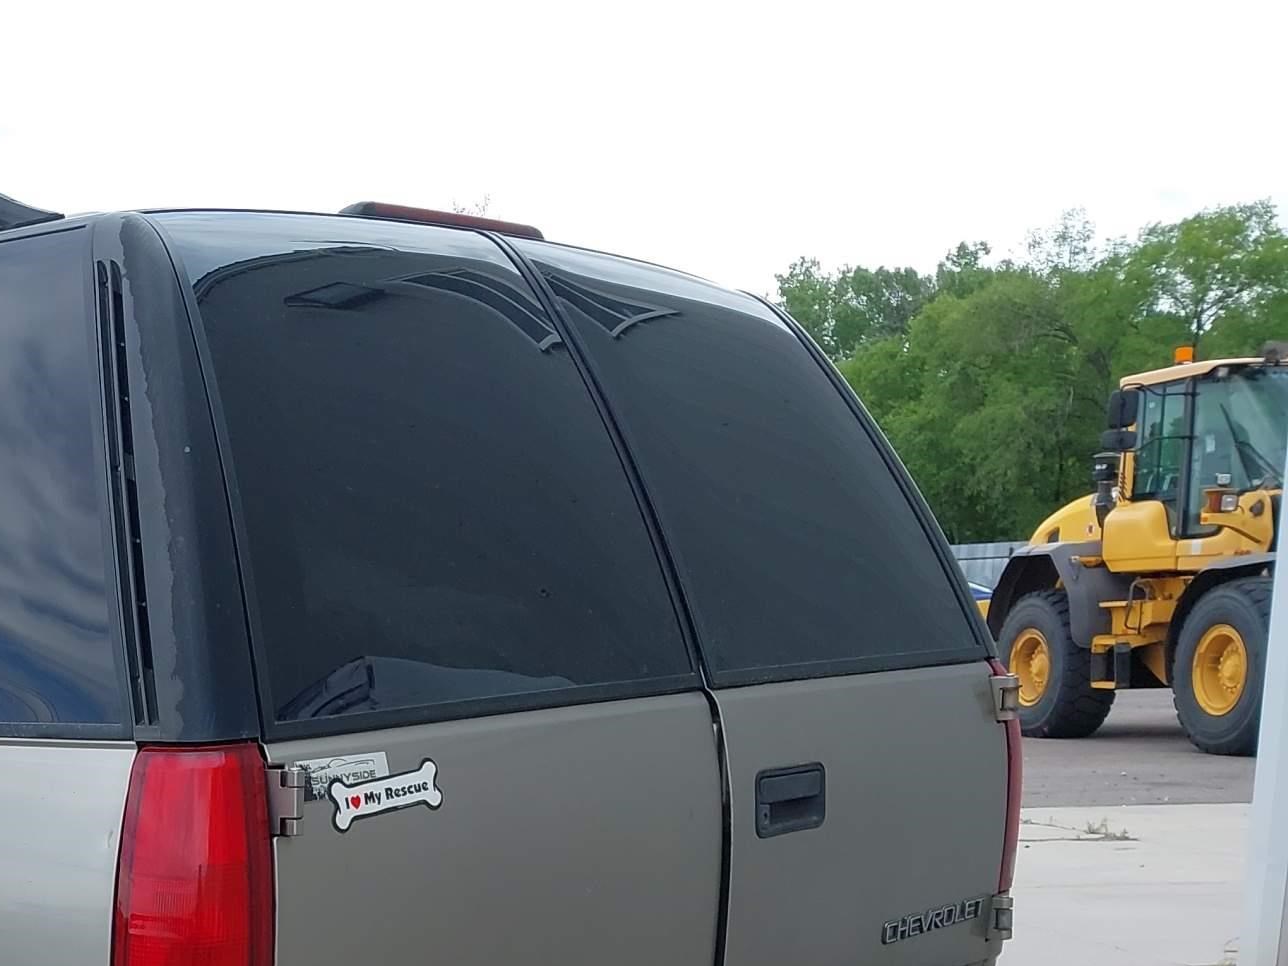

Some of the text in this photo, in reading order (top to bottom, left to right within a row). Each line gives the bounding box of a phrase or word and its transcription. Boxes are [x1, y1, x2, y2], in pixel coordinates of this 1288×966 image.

[345, 782, 429, 809] I My Rescue
[881, 897, 985, 944] CHEVROLET
